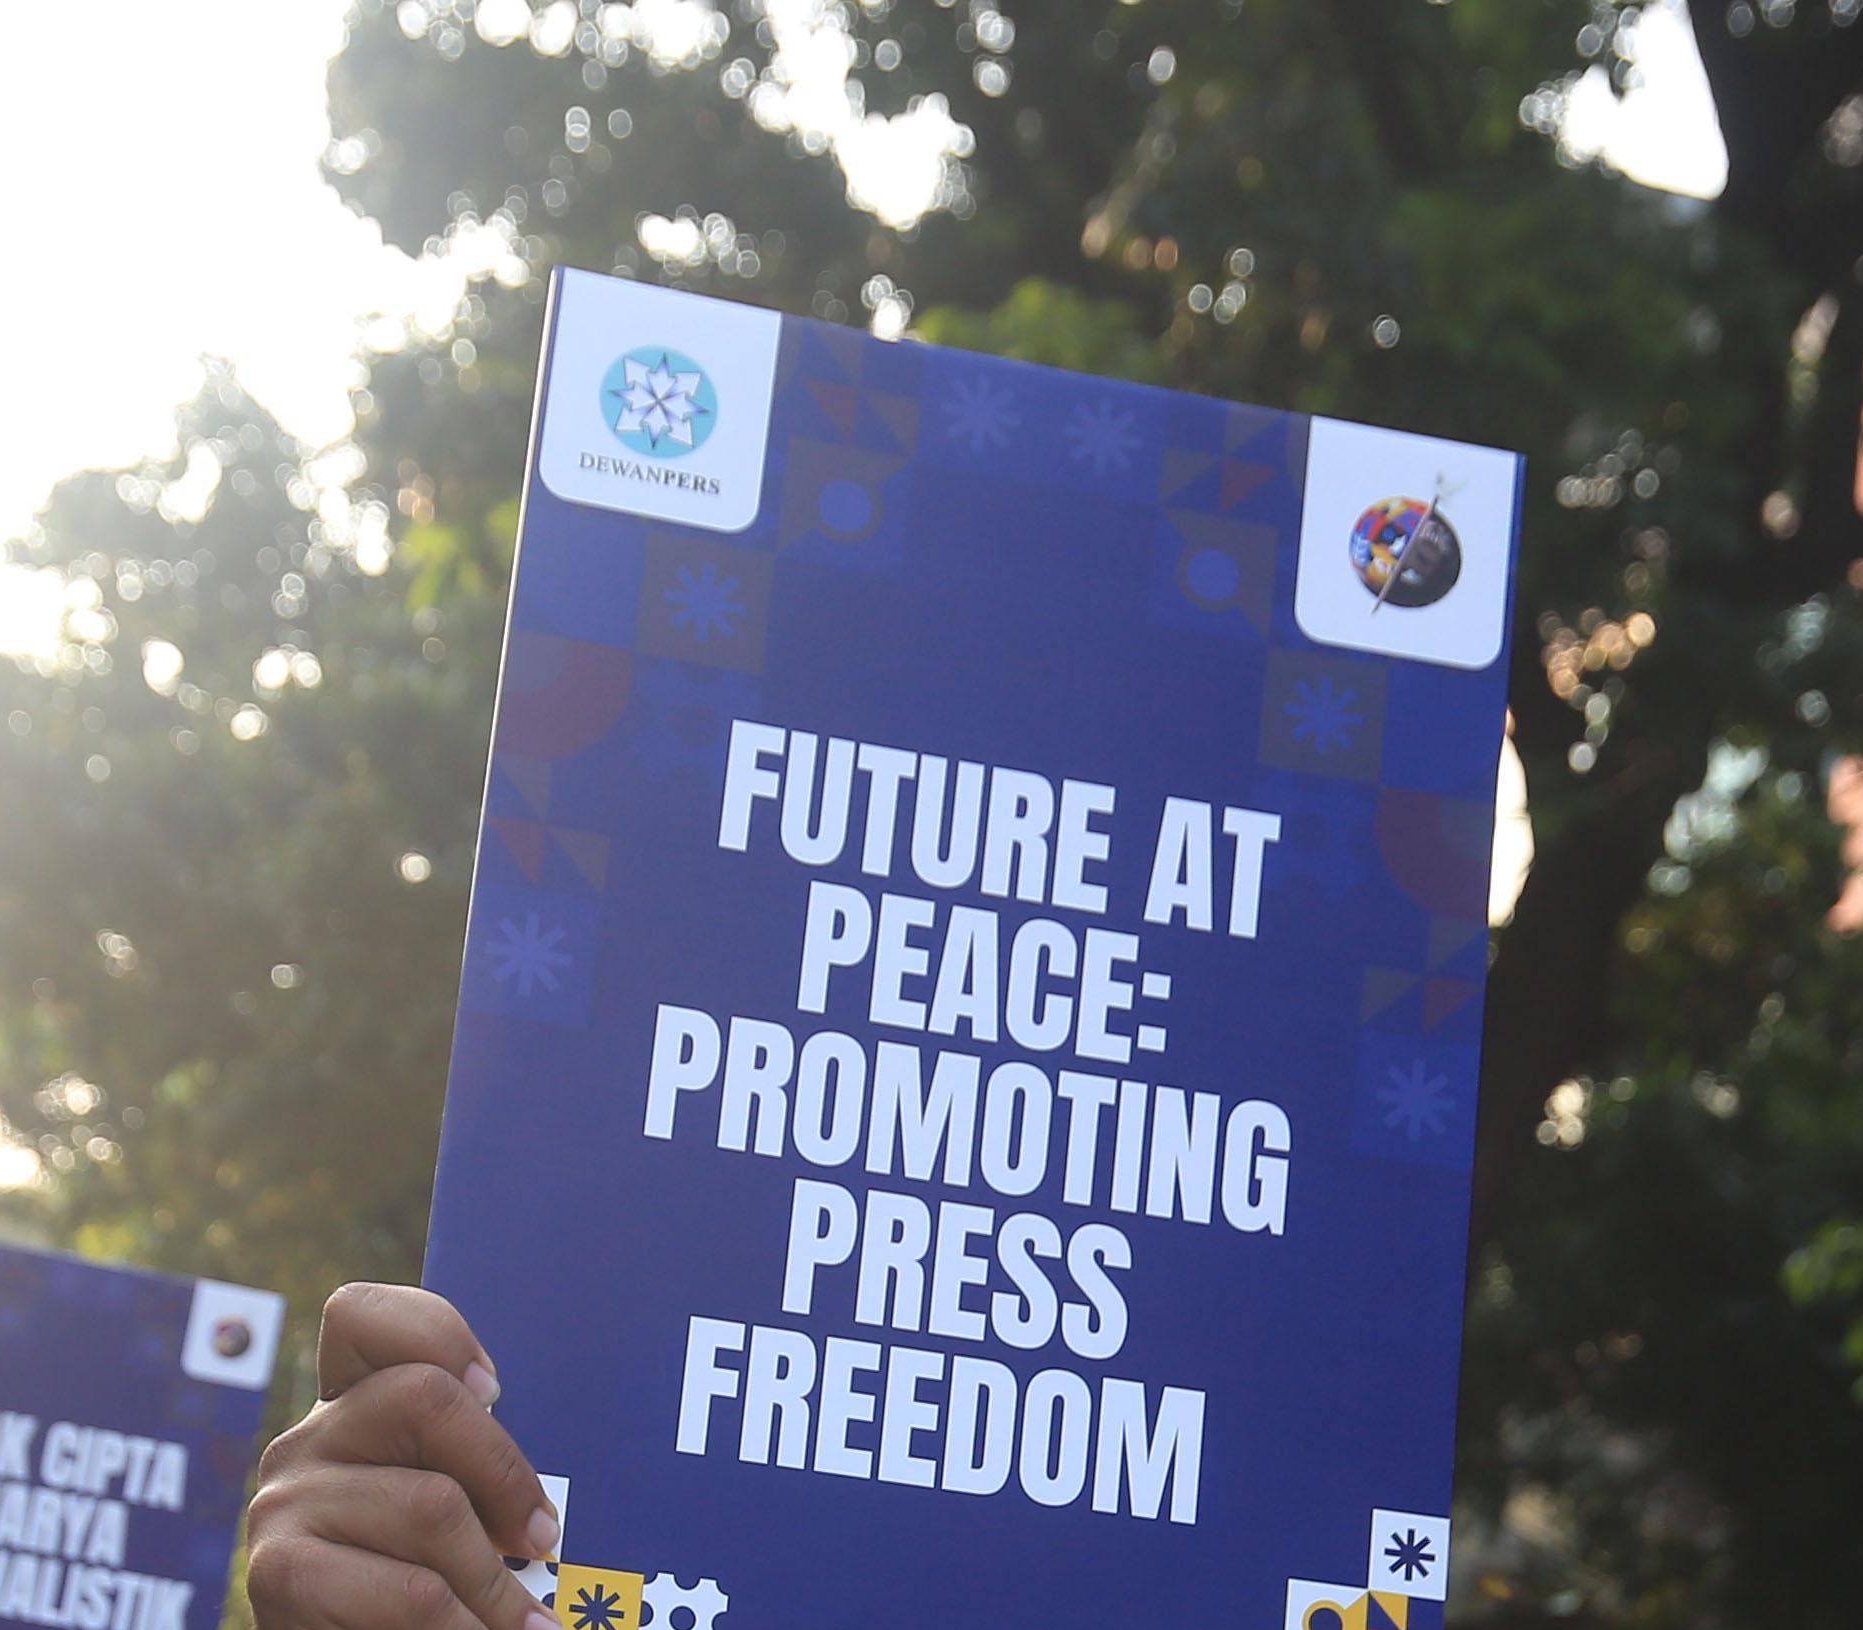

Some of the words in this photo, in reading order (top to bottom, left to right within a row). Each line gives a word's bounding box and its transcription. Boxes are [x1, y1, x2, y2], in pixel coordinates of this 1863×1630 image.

[717, 718, 1117, 915] FUTURE
[1142, 795, 1282, 940] AT
[796, 879, 1173, 1065] PEACE:
[642, 1002, 1292, 1237] PROMOTING
[780, 1176, 1133, 1361] PRESS
[40, 1420, 189, 1510] CIPTA
[674, 1314, 1207, 1526] FREEDOM
